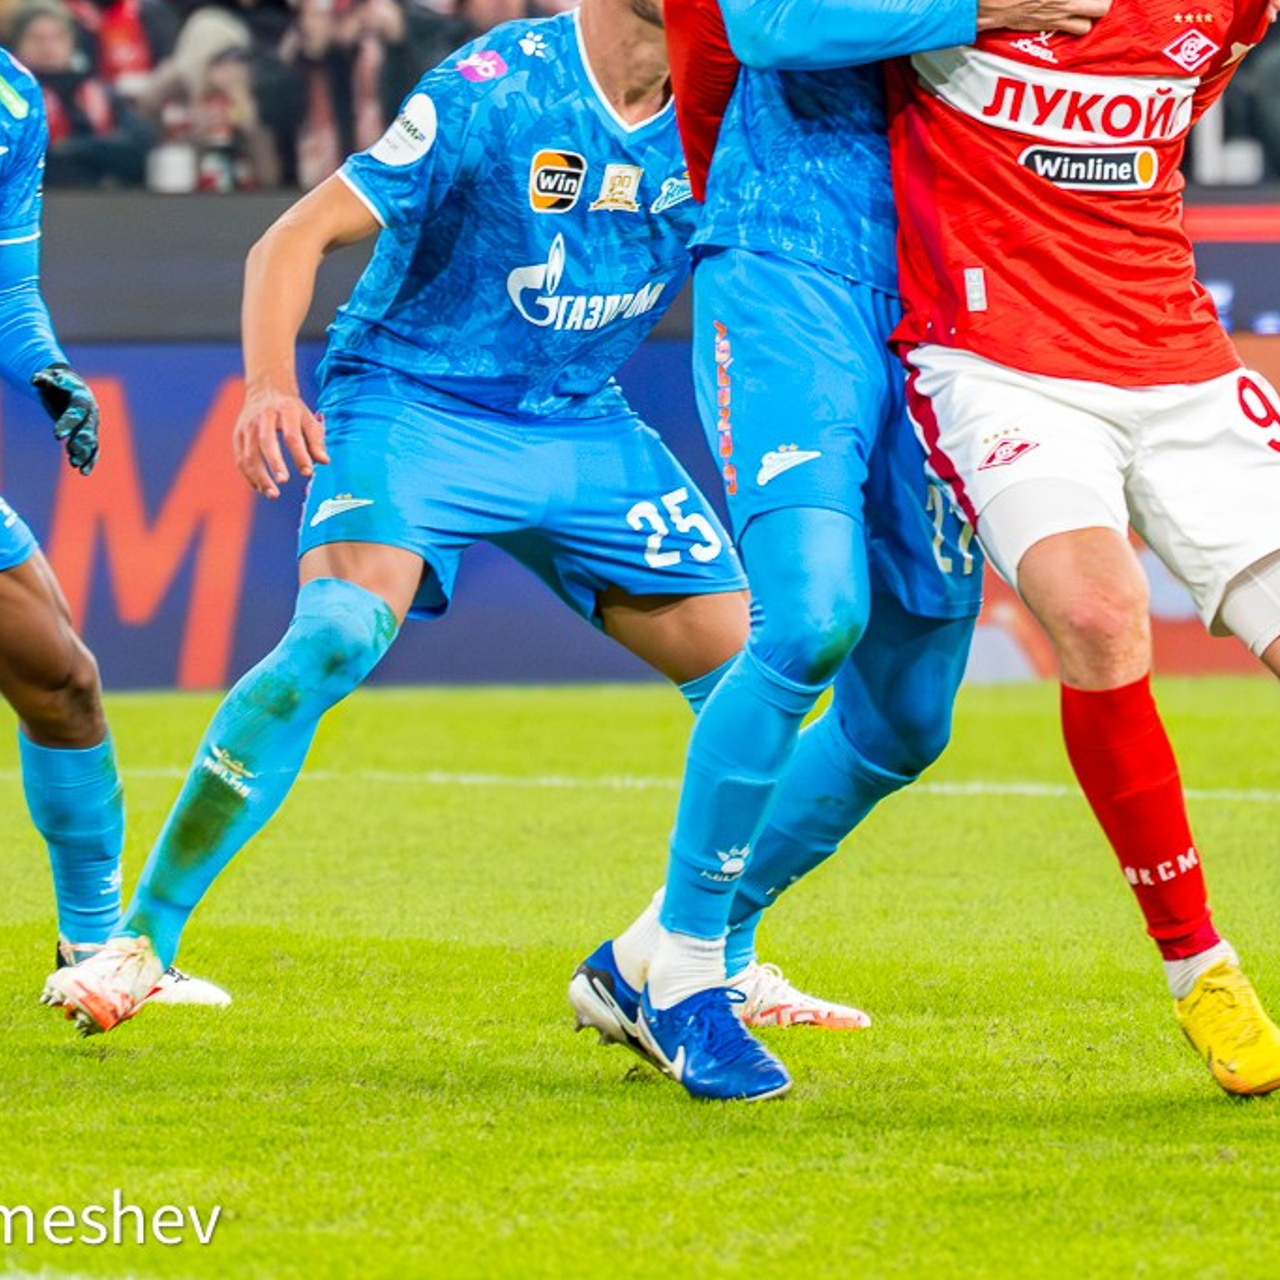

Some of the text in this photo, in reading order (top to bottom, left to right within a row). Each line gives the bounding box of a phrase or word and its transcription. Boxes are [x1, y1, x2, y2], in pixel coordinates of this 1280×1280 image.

[982, 76, 1190, 140] ЛУКОЙ
[538, 170, 578, 194] Win
[1033, 154, 1133, 181] Winline
[625, 486, 722, 569] 25
